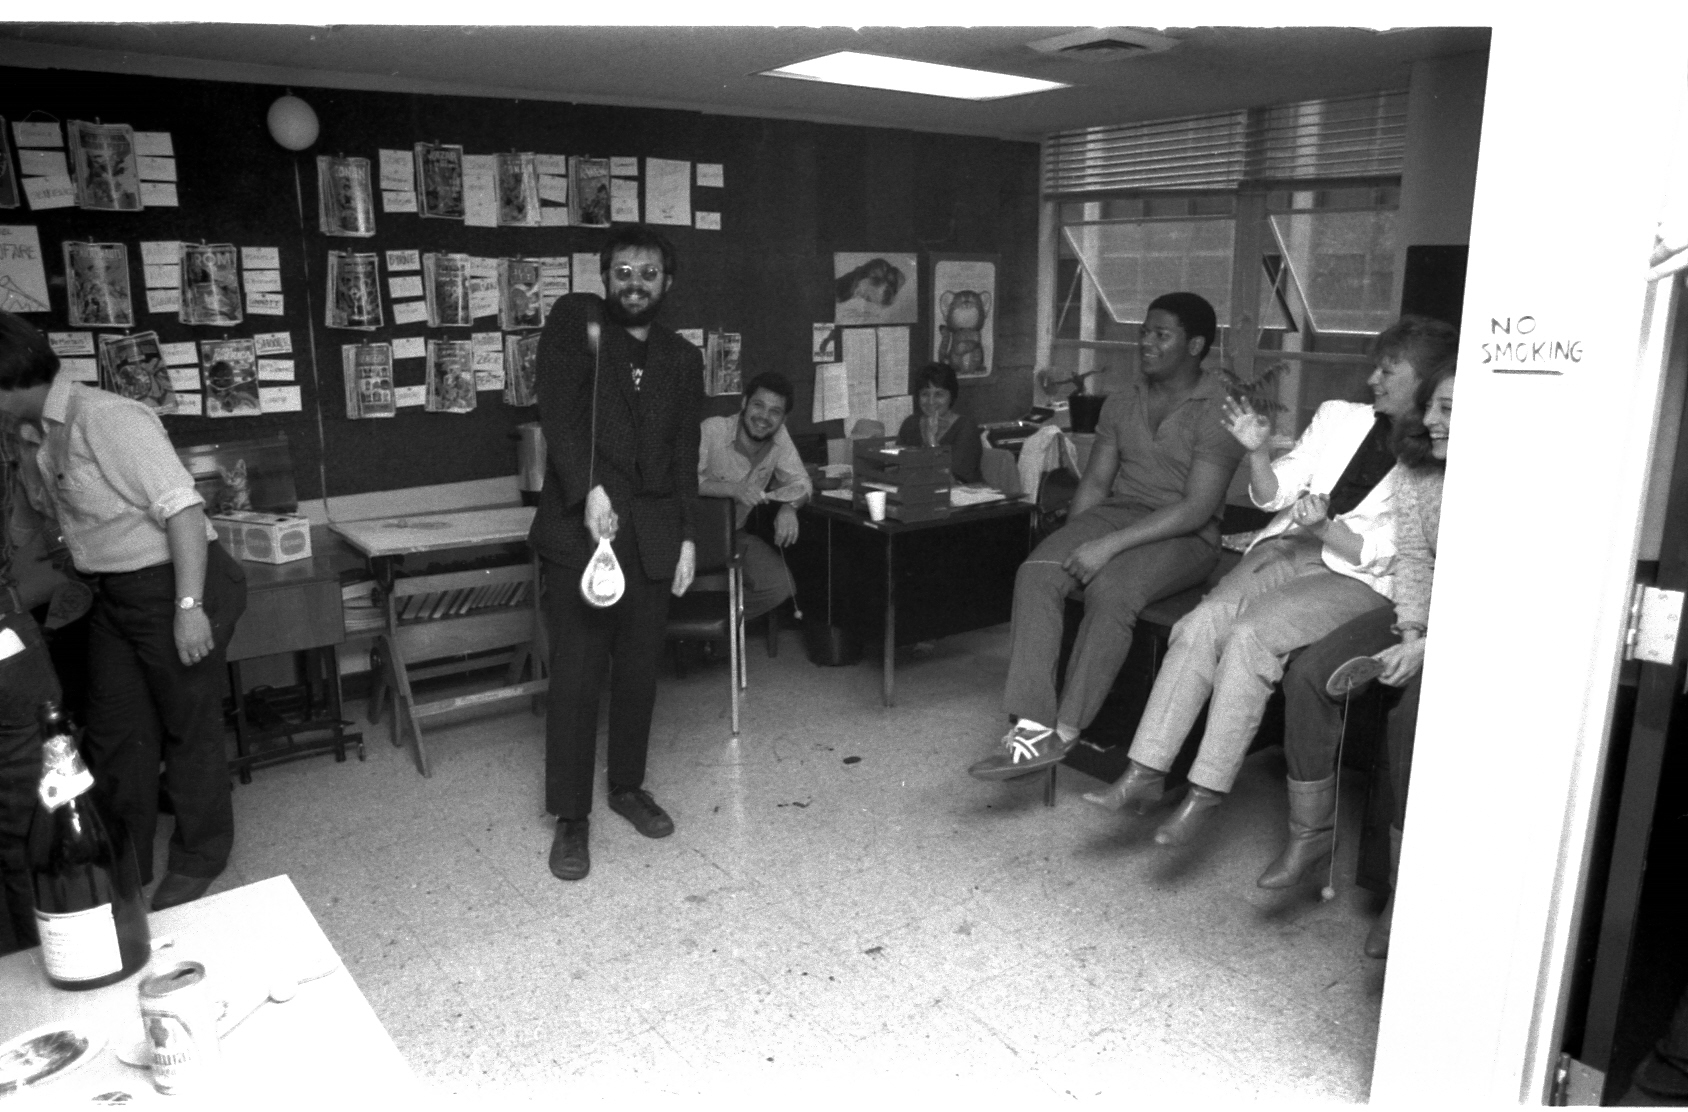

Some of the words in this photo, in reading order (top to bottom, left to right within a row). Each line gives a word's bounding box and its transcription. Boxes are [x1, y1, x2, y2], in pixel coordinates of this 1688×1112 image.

[193, 252, 231, 267] ROM
[1489, 314, 1538, 336] NO
[1480, 339, 1584, 365] SMOKING
